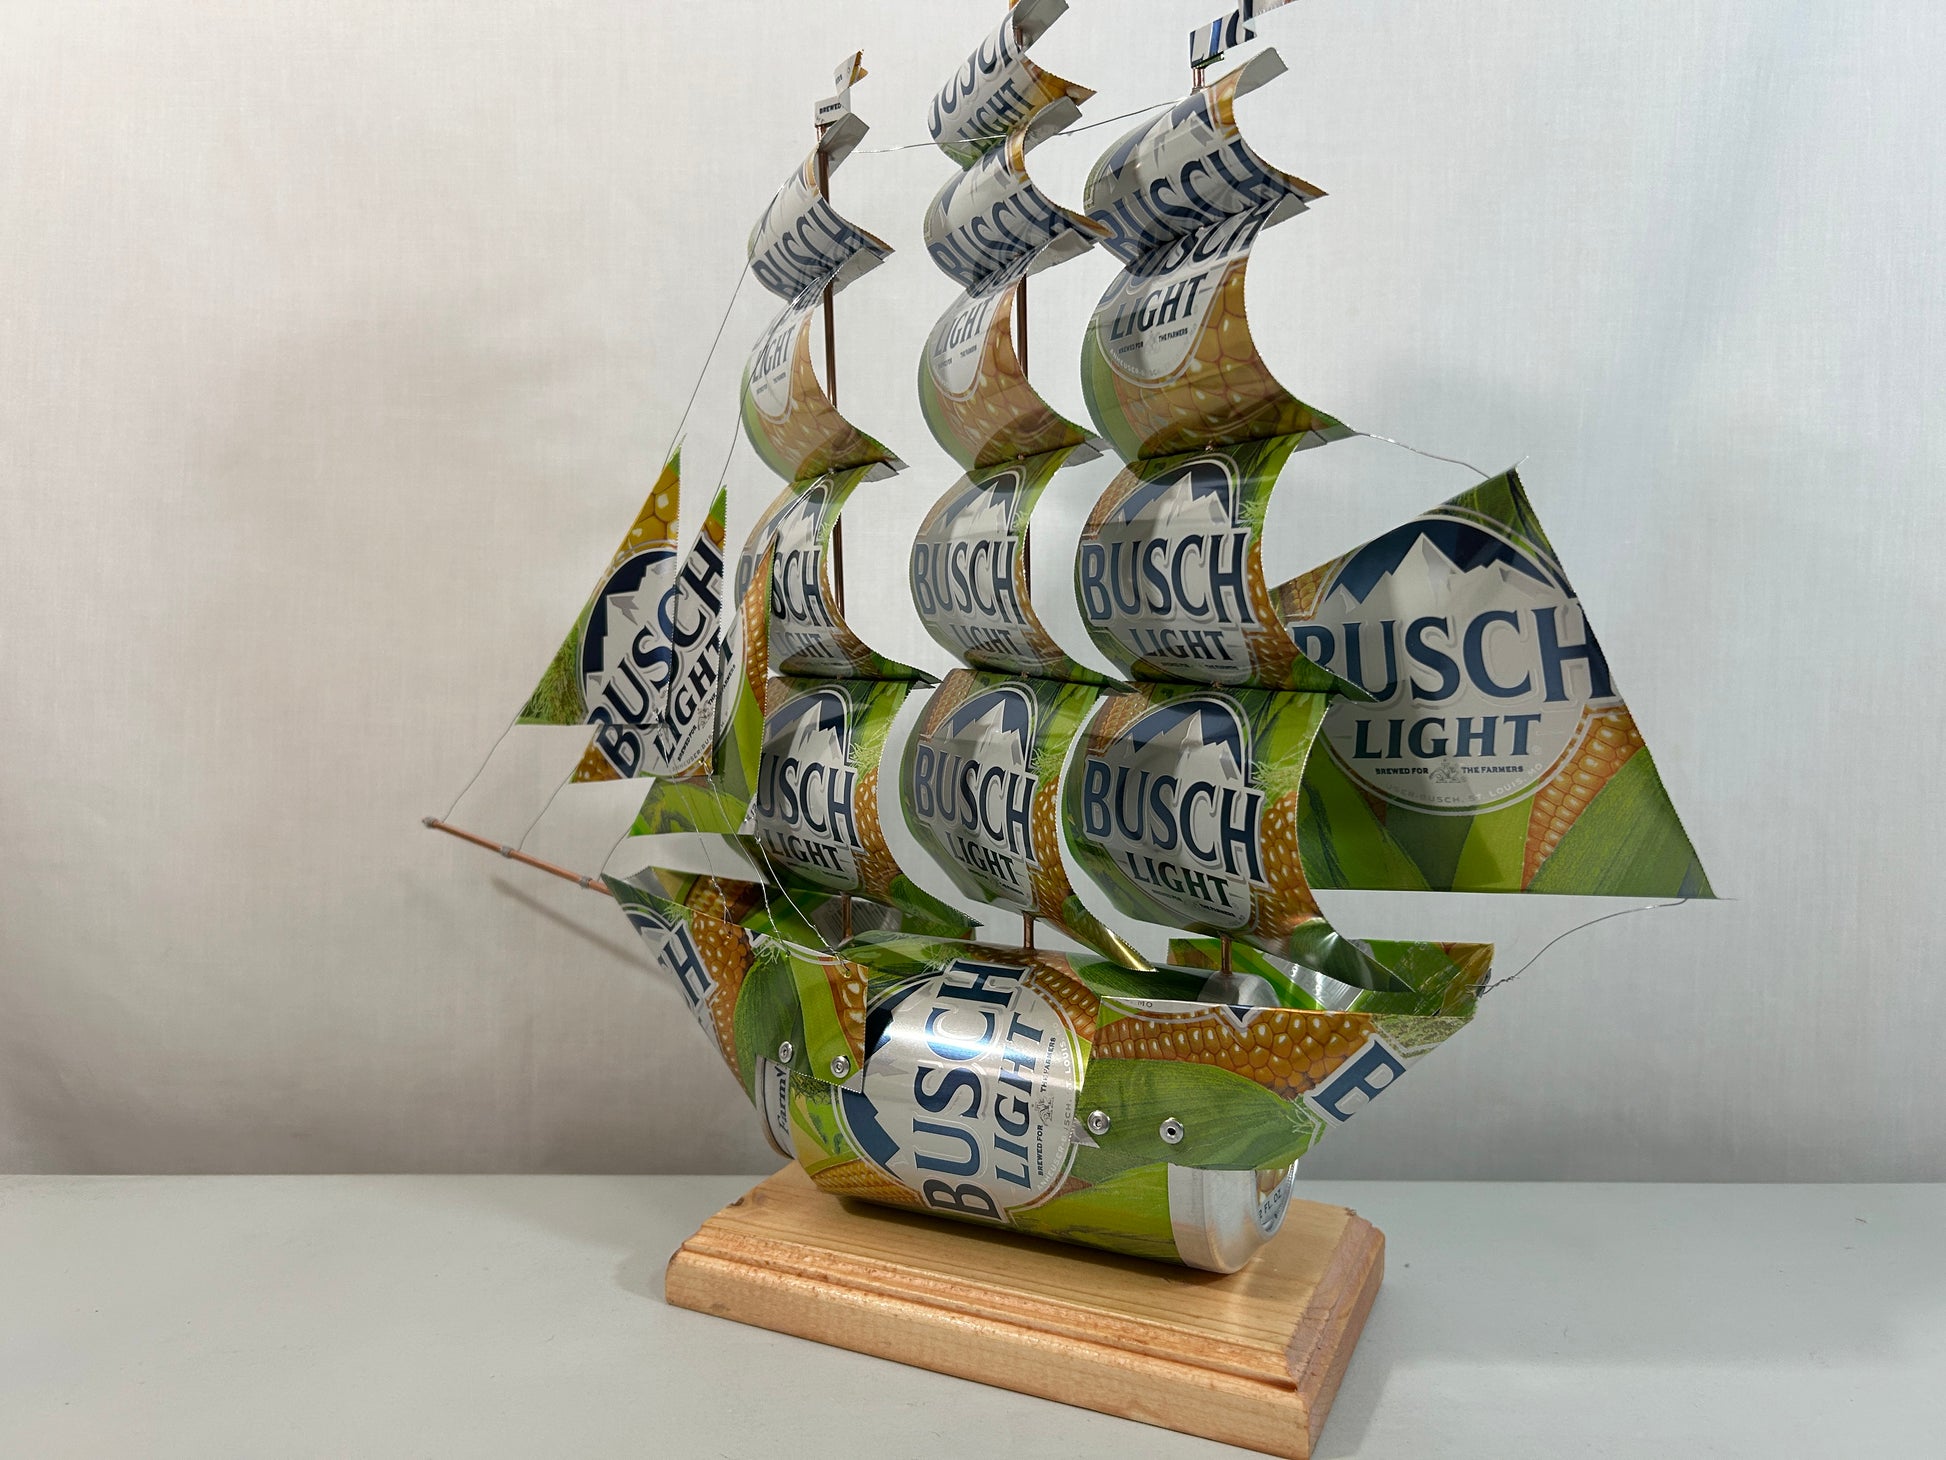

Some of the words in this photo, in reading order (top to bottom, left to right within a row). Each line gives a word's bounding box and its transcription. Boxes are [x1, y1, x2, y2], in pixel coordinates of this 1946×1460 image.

[956, 78, 1036, 154] LIGHT
[932, 295, 996, 360] LIGHT
[1109, 271, 1209, 341] LIGHT
[751, 324, 797, 385] LIGHT
[913, 540, 1028, 626] BUSCH
[1081, 532, 1256, 625] BUSCH
[950, 624, 1022, 657] LIGHT
[1128, 628, 1235, 661] LIGHT
[1352, 713, 1542, 760] LIGHT
[756, 751, 862, 849] USCH
[1375, 767, 1410, 775] BREWED
[1411, 767, 1429, 775] FOR
[1461, 766, 1480, 774] THE
[1480, 765, 1524, 774] FARMERS
[914, 744, 1036, 863] BUSCH
[1083, 759, 1267, 884] BUSCH
[762, 827, 845, 873] LIGHT
[945, 831, 1020, 887] LIGHT
[1125, 851, 1233, 909] LIGHT
[911, 959, 1027, 1221] BUSCH
[993, 1011, 1045, 1190] LIGHT
[1036, 1124, 1044, 1142] FOR
[1036, 1141, 1044, 1177] BREWED
